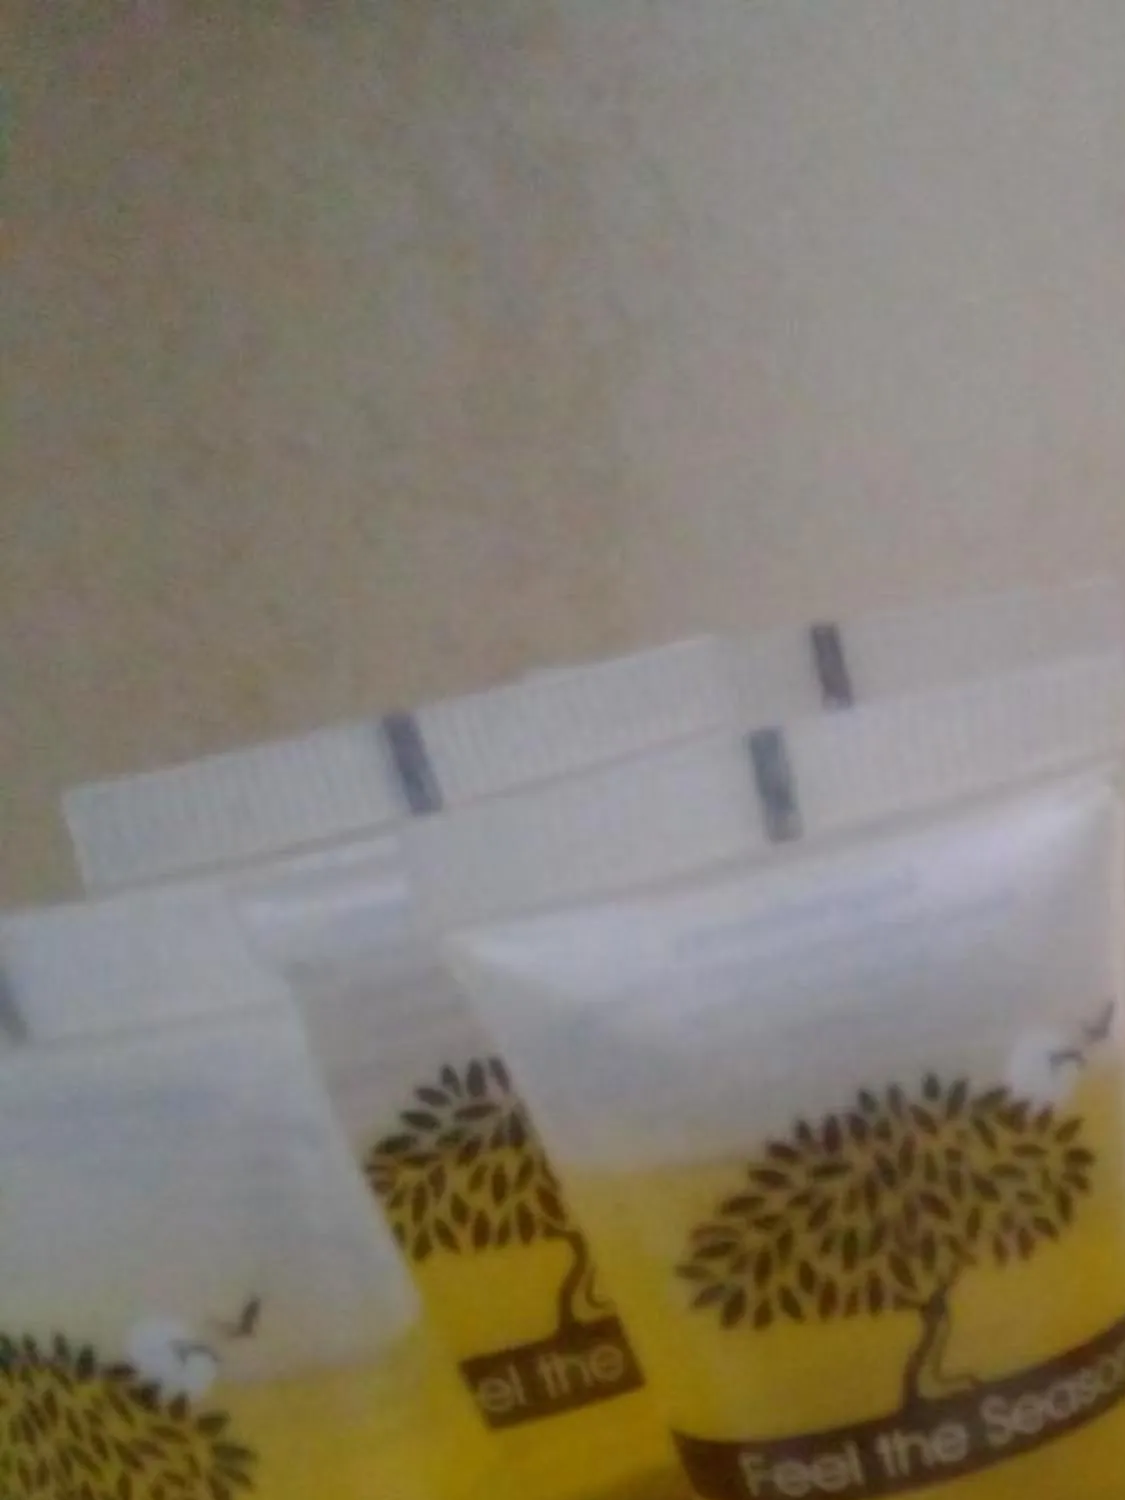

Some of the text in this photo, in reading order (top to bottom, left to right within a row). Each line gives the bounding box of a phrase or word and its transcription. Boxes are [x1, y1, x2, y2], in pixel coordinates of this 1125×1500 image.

[536, 1344, 624, 1399] the
[738, 1443, 866, 1500] Feel
[876, 1416, 971, 1479] the
